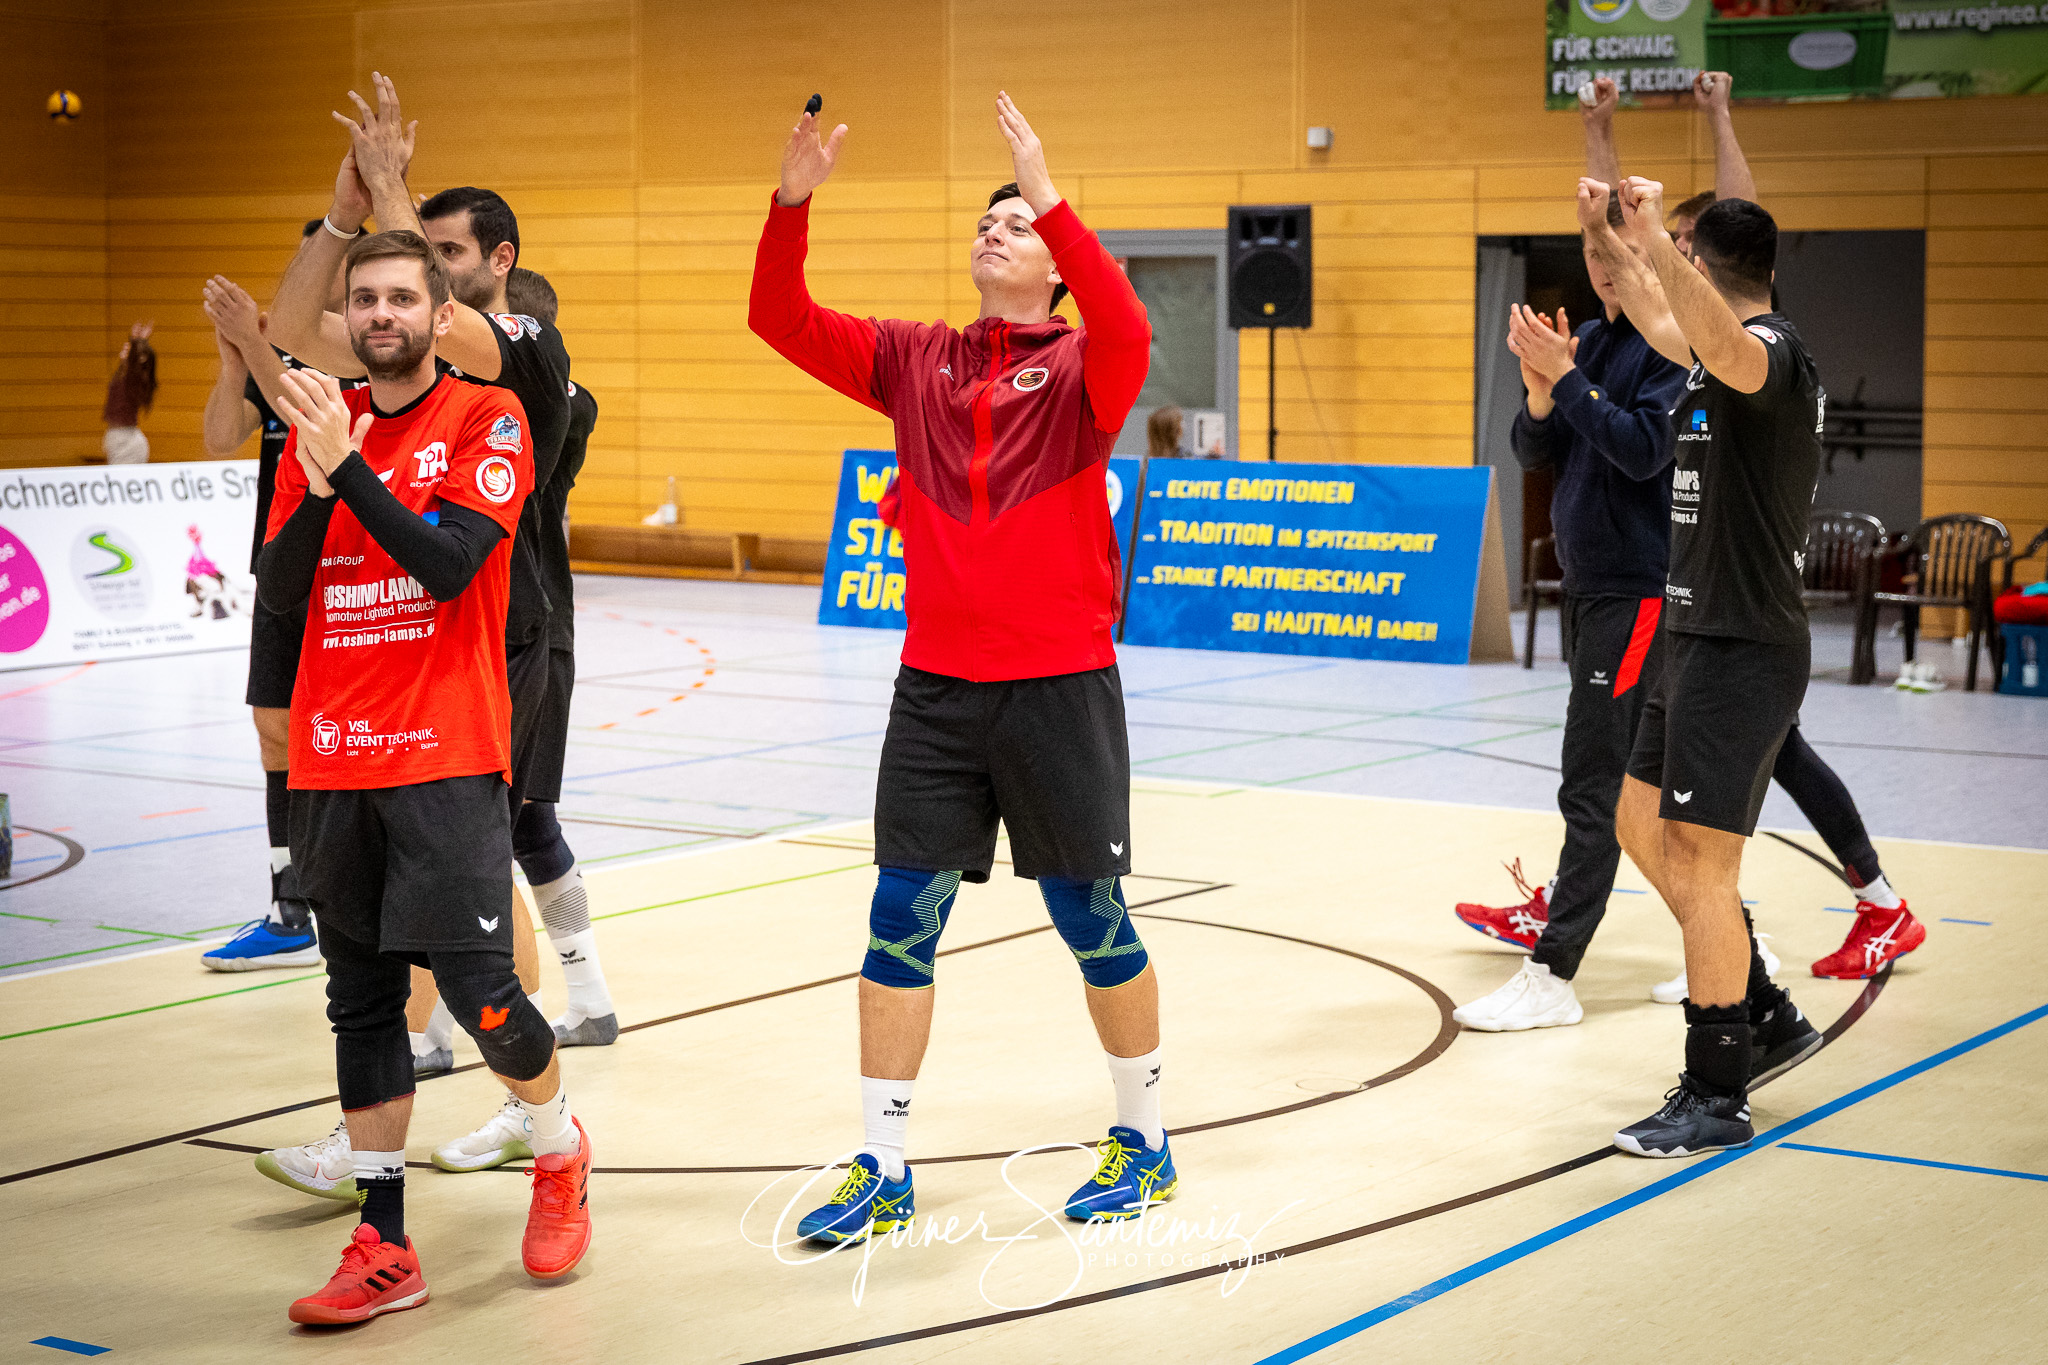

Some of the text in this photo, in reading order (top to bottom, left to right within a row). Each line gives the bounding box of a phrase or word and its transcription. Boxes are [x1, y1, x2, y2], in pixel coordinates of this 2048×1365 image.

[1552, 34, 1592, 62] FÜR
[1552, 66, 1592, 95] FÜR
[0, 473, 163, 511] chnarchen
[171, 470, 214, 501] die
[1226, 478, 1355, 504] EMOTIONEN
[1159, 519, 1274, 547] TRADITION
[1277, 528, 1303, 547] IM
[1305, 529, 1438, 552] SPITZENSPORT
[380, 576, 432, 603] LAMP
[837, 562, 907, 611] FÜR
[1151, 565, 1217, 587] STARKE
[1221, 565, 1406, 596] PARTNERSCHAFT
[364, 604, 395, 621] Lighted
[1231, 612, 1260, 632] SEI
[1264, 610, 1373, 638] HAUTNAH
[348, 720, 373, 733] VSL
